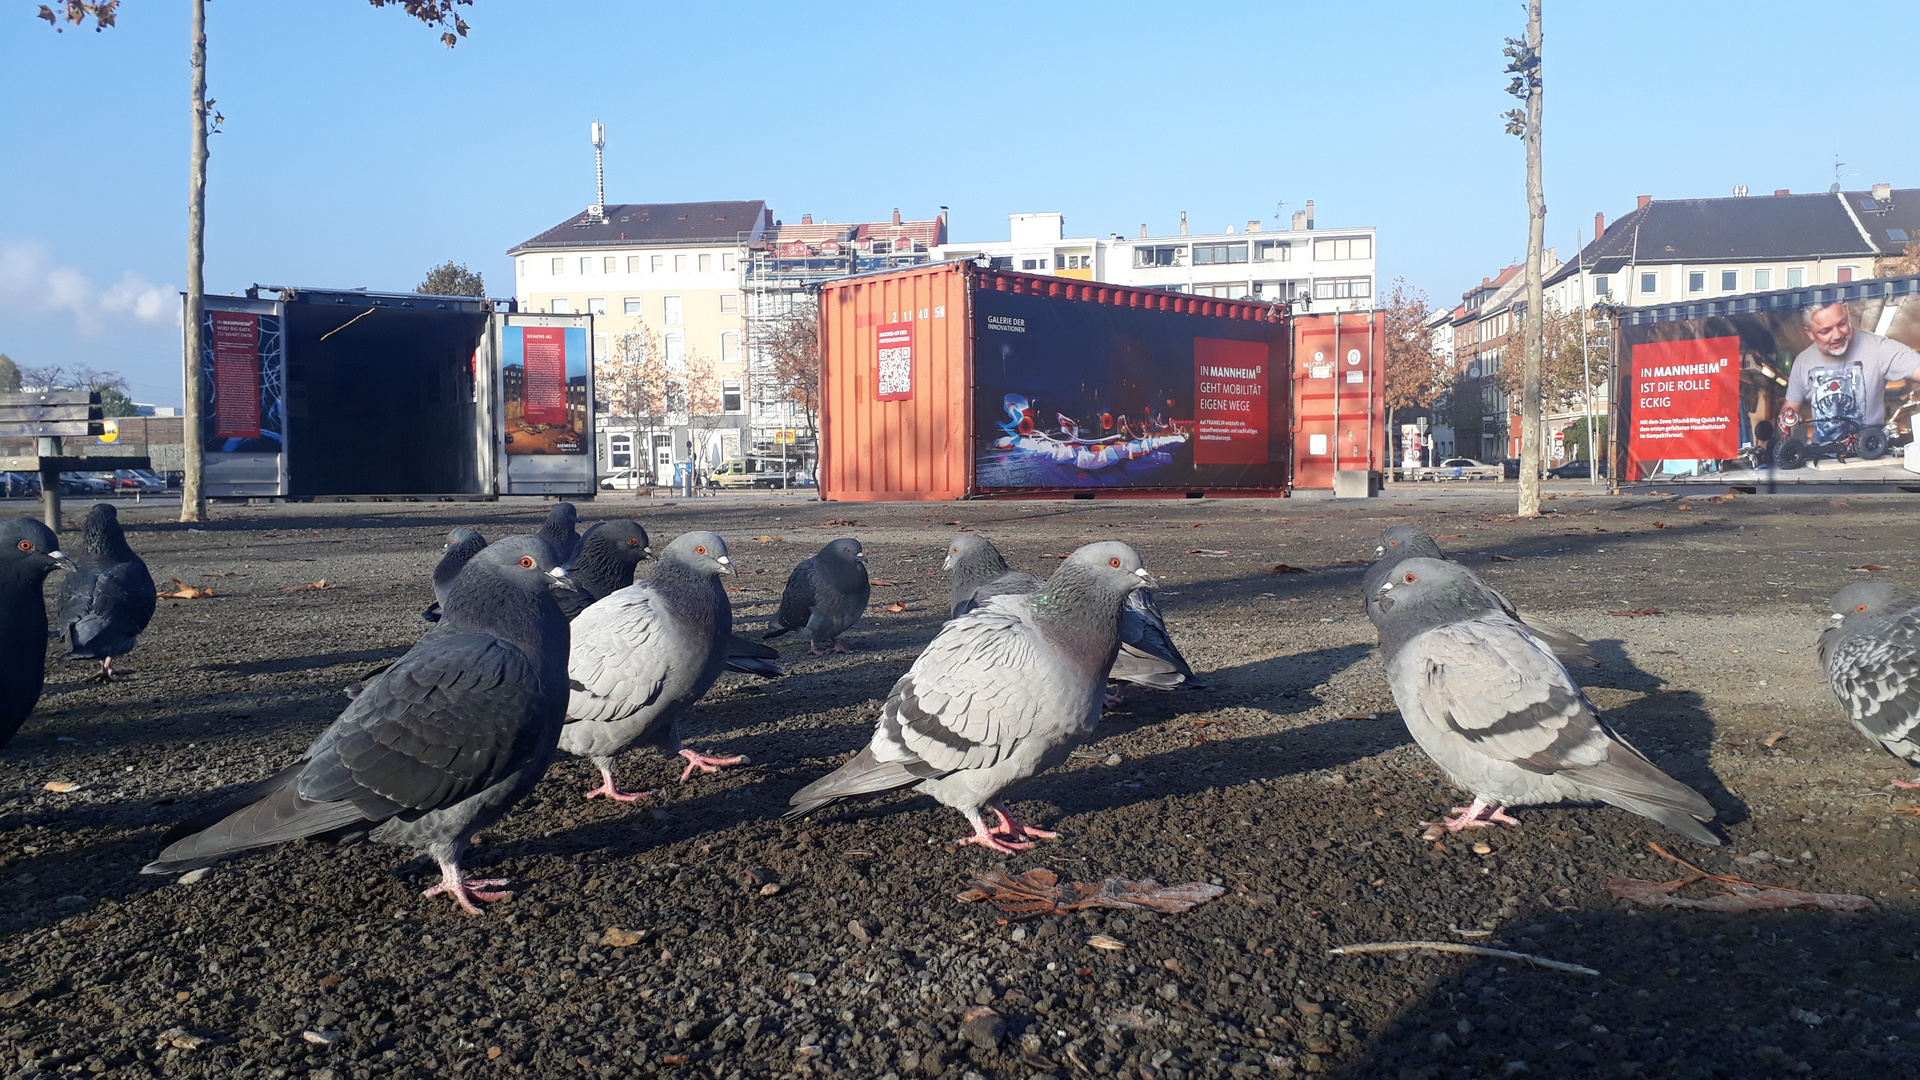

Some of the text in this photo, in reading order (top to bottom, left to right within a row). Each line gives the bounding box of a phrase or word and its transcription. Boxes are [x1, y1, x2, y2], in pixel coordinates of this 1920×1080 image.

[892, 311, 897, 323] 2
[903, 309, 912, 322] 11
[918, 308, 928, 320] 40
[987, 315, 1025, 326] GALERIE DER
[987, 323, 1025, 333] INNOVATIONEN
[1200, 365, 1209, 376] IN
[1641, 368, 1652, 378] IN
[1200, 381, 1262, 396] GEHT MOBILITÄT
[1641, 379, 1710, 393] IST DIE ROLLE
[1200, 398, 1251, 412] EIGENE WEGE
[1640, 397, 1671, 408] ECKIG
[1701, 416, 1716, 424] Quick
[1665, 425, 1689, 433] gefalteten
[1690, 423, 1726, 431] Haushaltstuch
